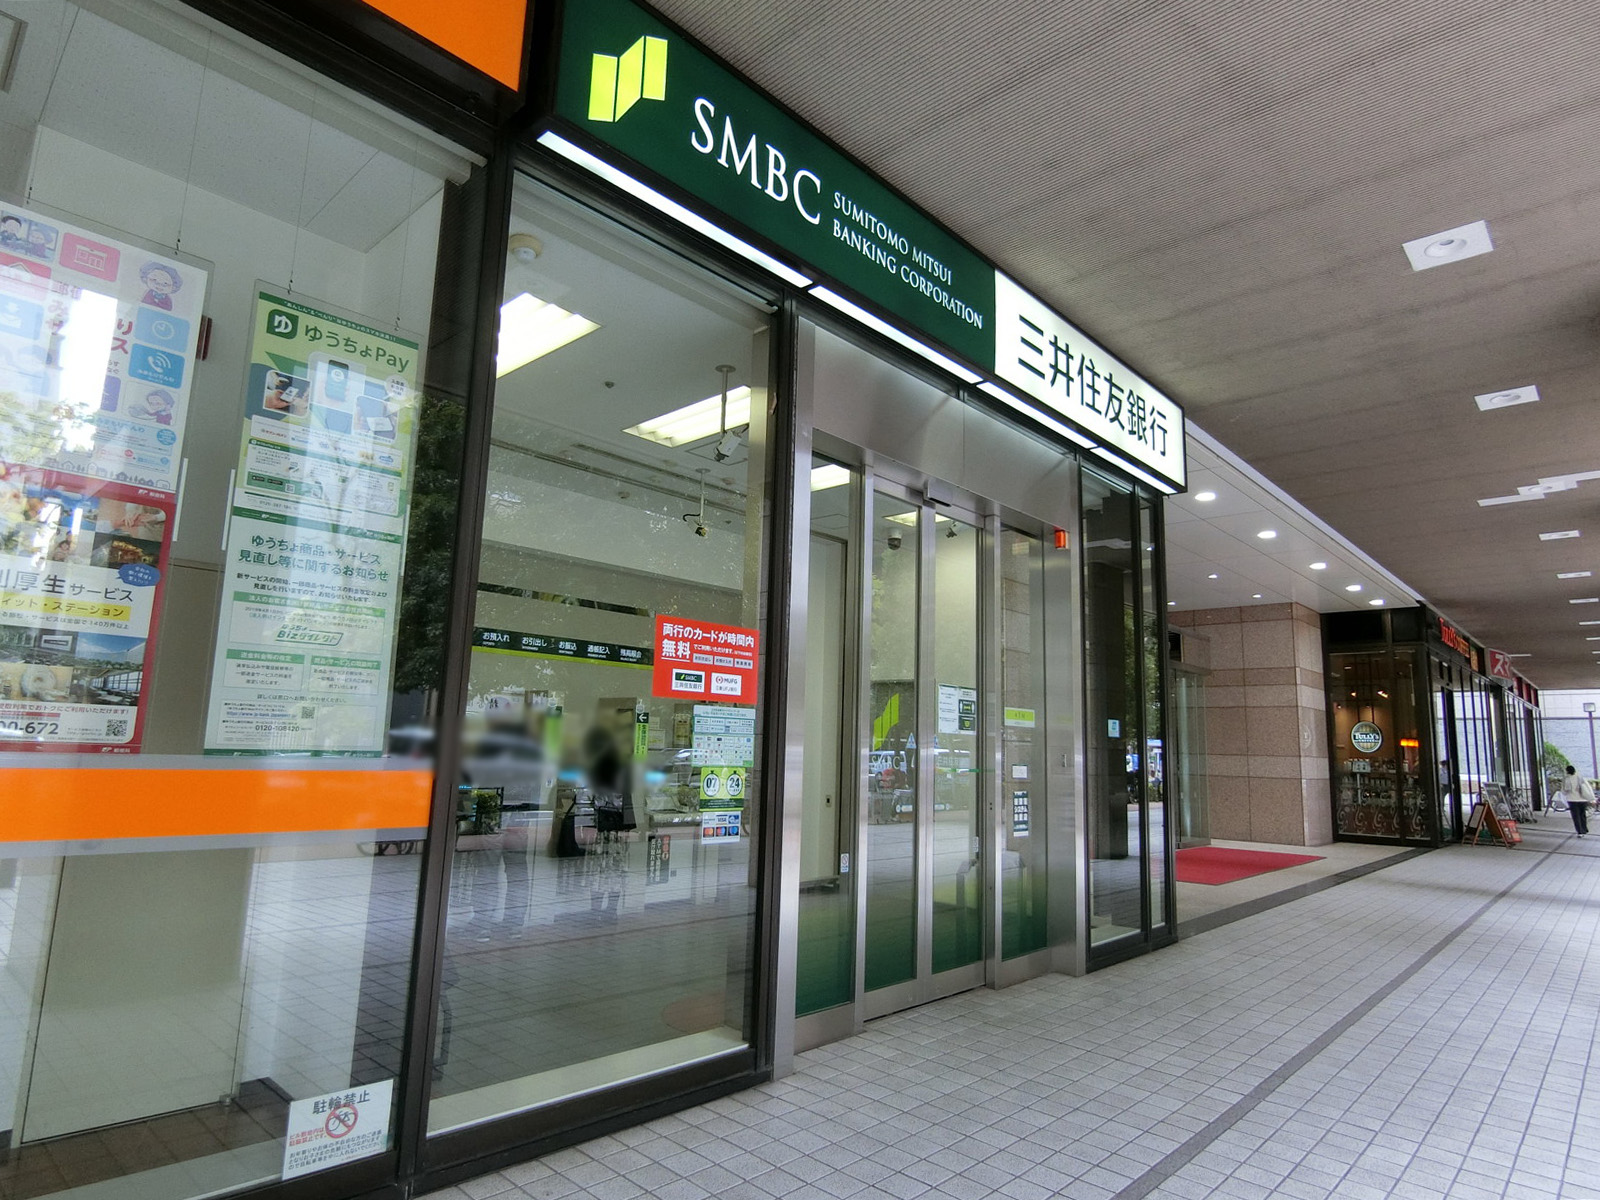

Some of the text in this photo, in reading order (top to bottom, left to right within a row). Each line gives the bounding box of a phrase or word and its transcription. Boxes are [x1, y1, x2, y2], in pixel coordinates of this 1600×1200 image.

[691, 97, 821, 225] SMBC
[833, 191, 953, 286] SUMITOMO MITSUI
[833, 218, 983, 330] BANKING CORPORATION
[304, 323, 411, 373] ゆうちょPay
[1017, 314, 1168, 458] 三井住友銀行
[251, 535, 382, 565] ゆうちょ商品・サービス
[238, 550, 389, 582] 見直し等に関するお知らせ
[482, 632, 510, 642] お預入れ
[522, 636, 548, 647] お引出し
[661, 638, 691, 659] 無料
[662, 622, 755, 648] 両行のカードが時間内
[706, 777, 717, 788] 07
[729, 777, 740, 788] 24
[312, 1090, 370, 1114] 駐輪禁止
